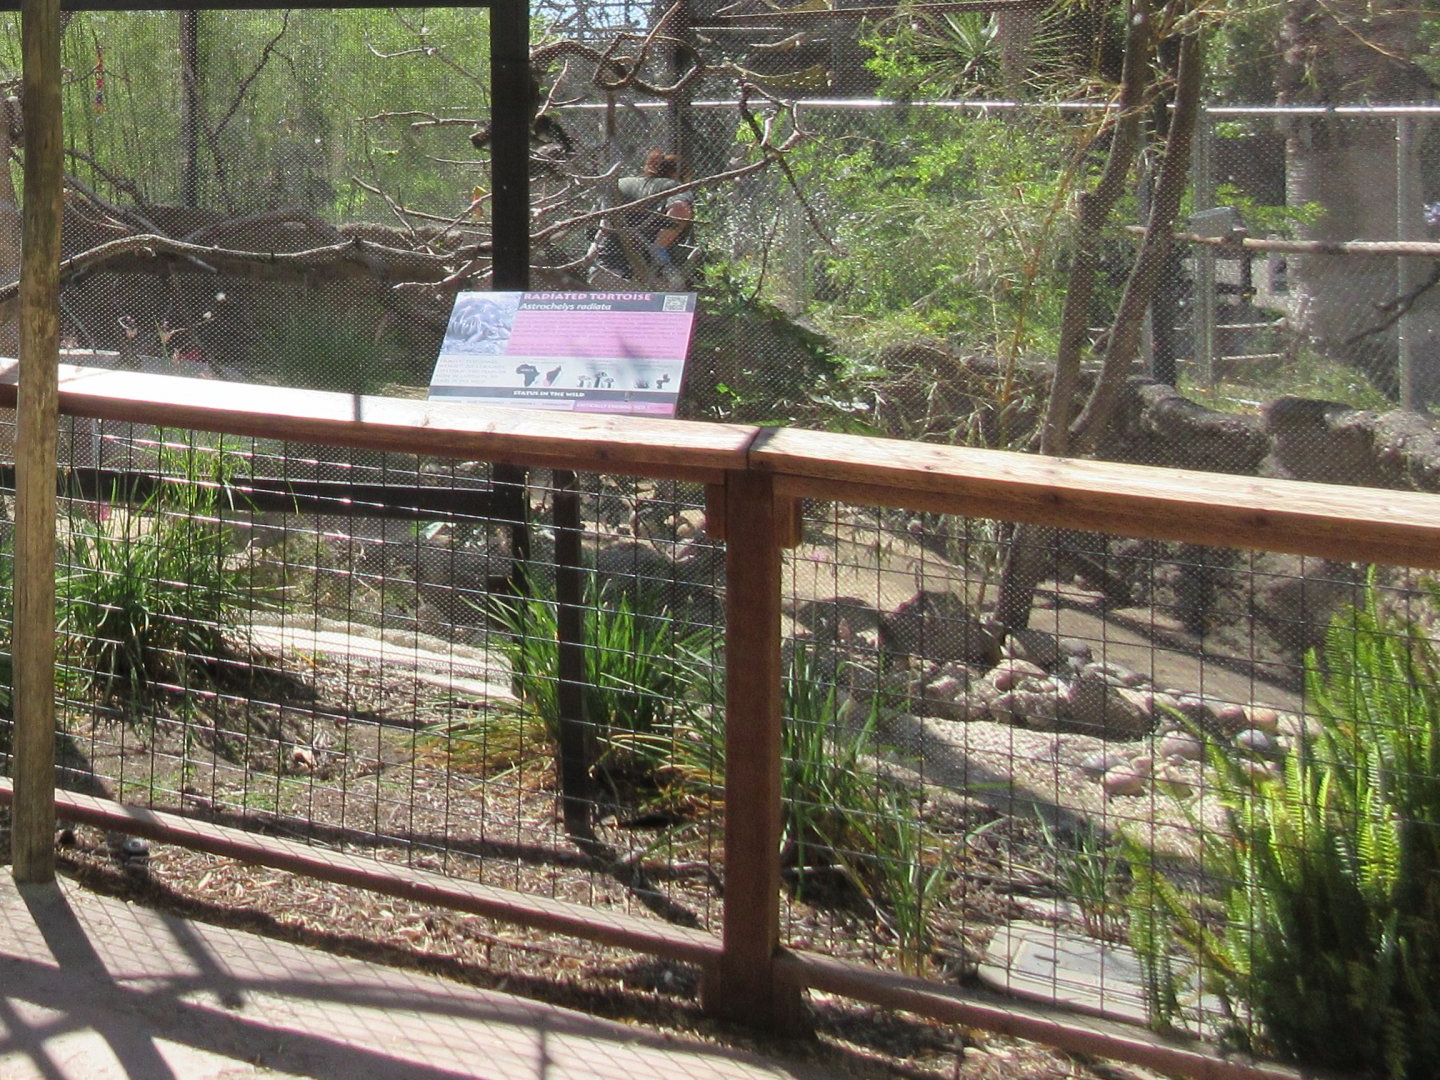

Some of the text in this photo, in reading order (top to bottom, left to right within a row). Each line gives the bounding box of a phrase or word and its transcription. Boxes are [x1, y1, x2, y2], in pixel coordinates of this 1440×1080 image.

[524, 292, 652, 301] RADIATED TORTOISE
[519, 302, 612, 311] Astrochelys radiata
